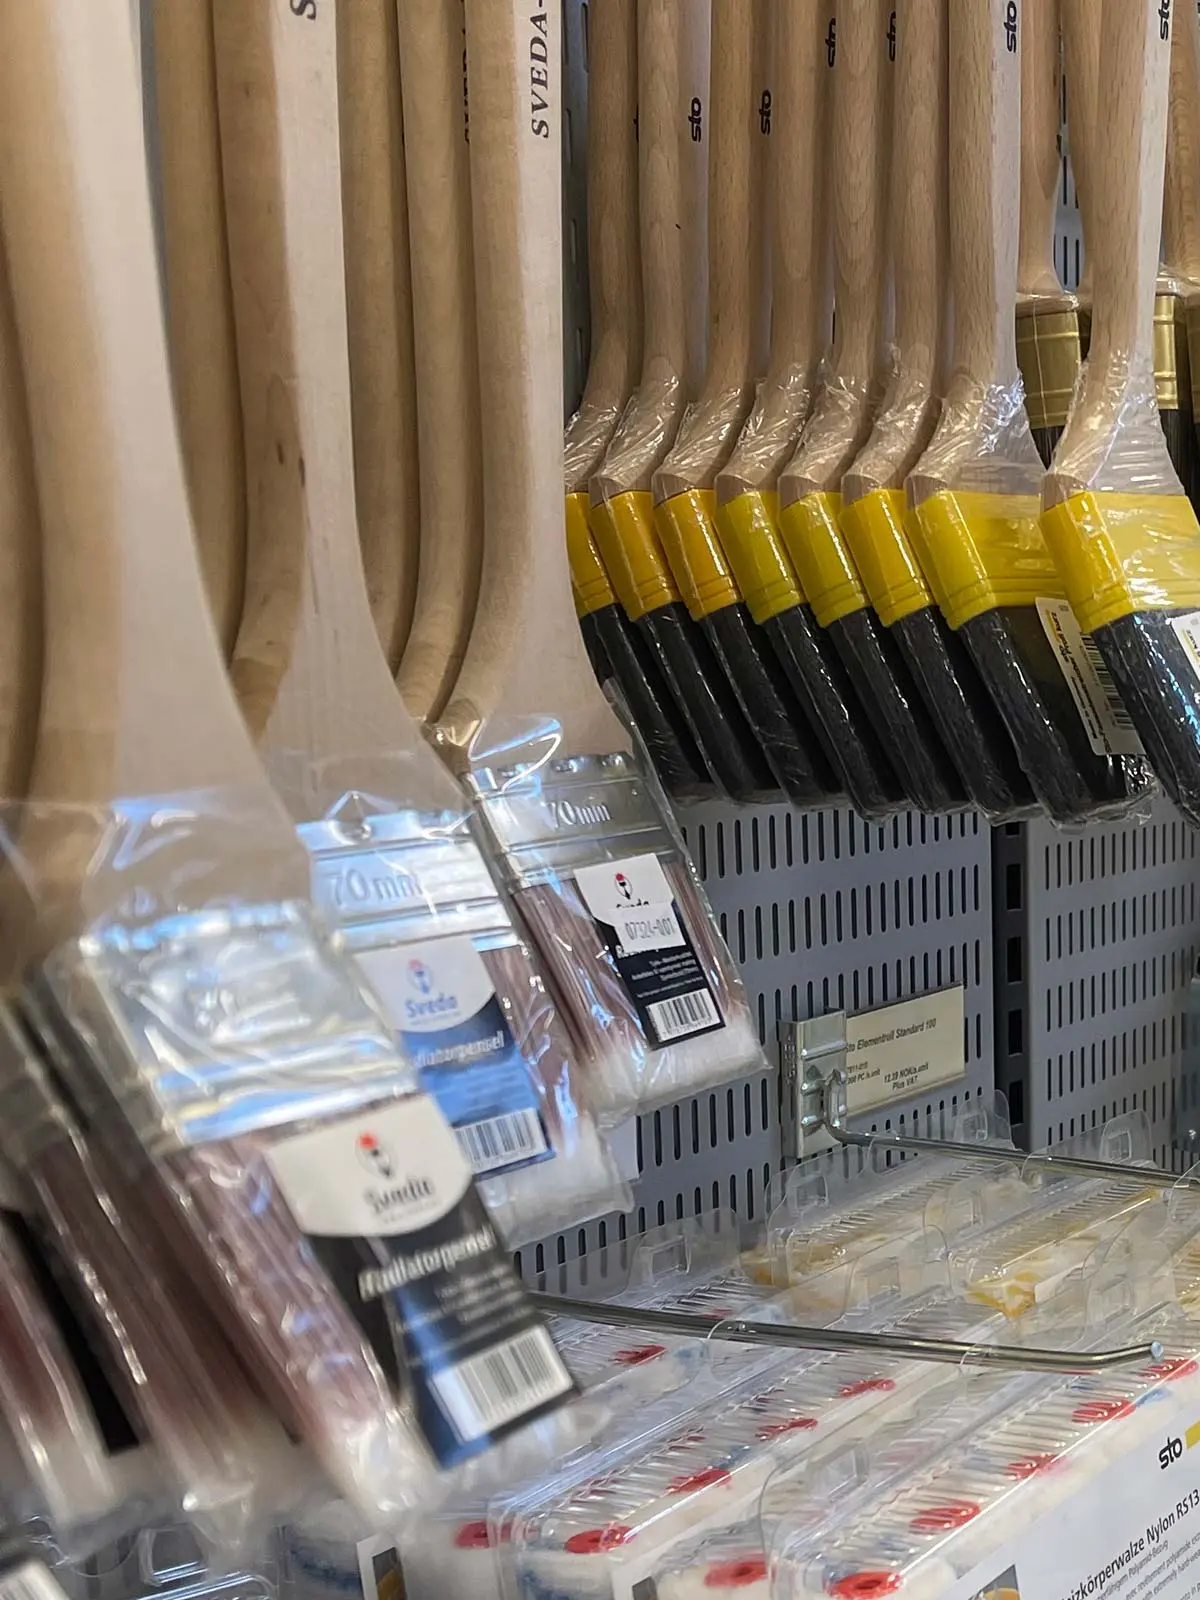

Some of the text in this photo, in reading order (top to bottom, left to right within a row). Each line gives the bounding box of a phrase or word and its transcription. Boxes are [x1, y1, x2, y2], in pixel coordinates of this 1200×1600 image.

[1004, 0, 1017, 53] sto
[688, 97, 702, 142] sto
[759, 89, 773, 135] sto
[896, 1022, 925, 1039] Standard
[1158, 1436, 1183, 1470] sto
[1061, 1488, 1200, 1600] izkörperwalze Nylon RS13
